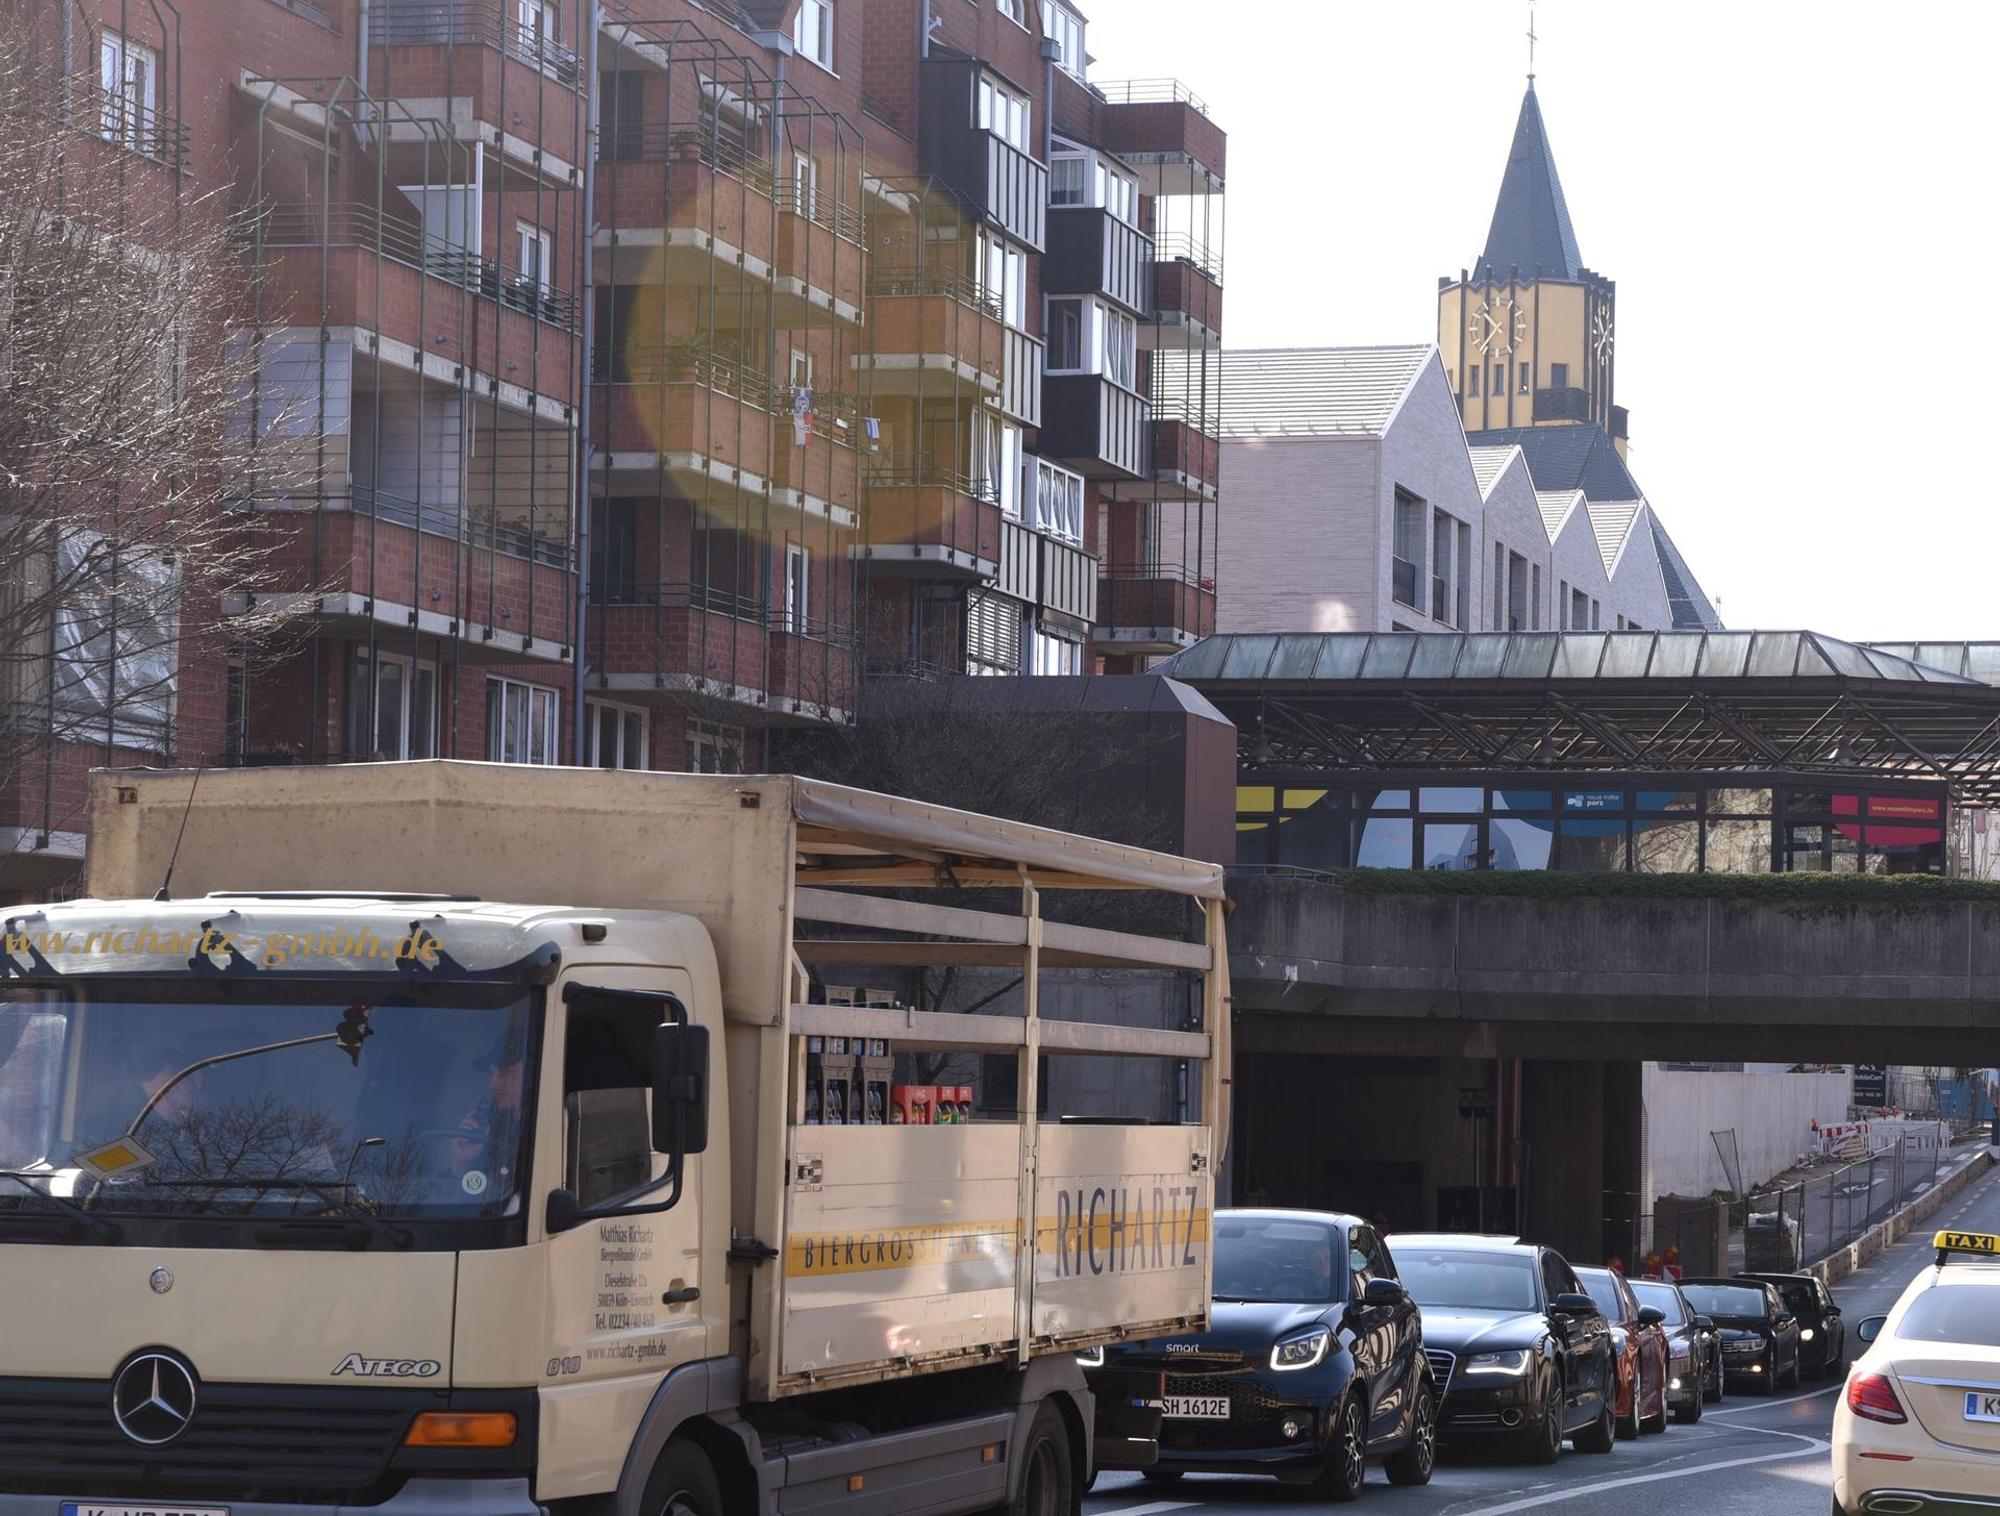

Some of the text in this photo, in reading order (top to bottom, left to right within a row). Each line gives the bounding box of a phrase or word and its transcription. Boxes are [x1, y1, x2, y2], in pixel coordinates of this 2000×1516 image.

[600, 1224, 653, 1243] Matthias Richartz
[1056, 1186, 1198, 1278] RICHARTZ
[1948, 1233, 1993, 1250] TAXI
[595, 1313, 607, 1330] Tel.
[586, 1339, 667, 1363] www.richartz-gmbh.de
[1166, 1343, 1200, 1353] smart
[330, 1353, 441, 1377] ATEGO
[1162, 1399, 1180, 1415] SH
[1183, 1399, 1228, 1416] 1612E
[1984, 1397, 1996, 1416] K
